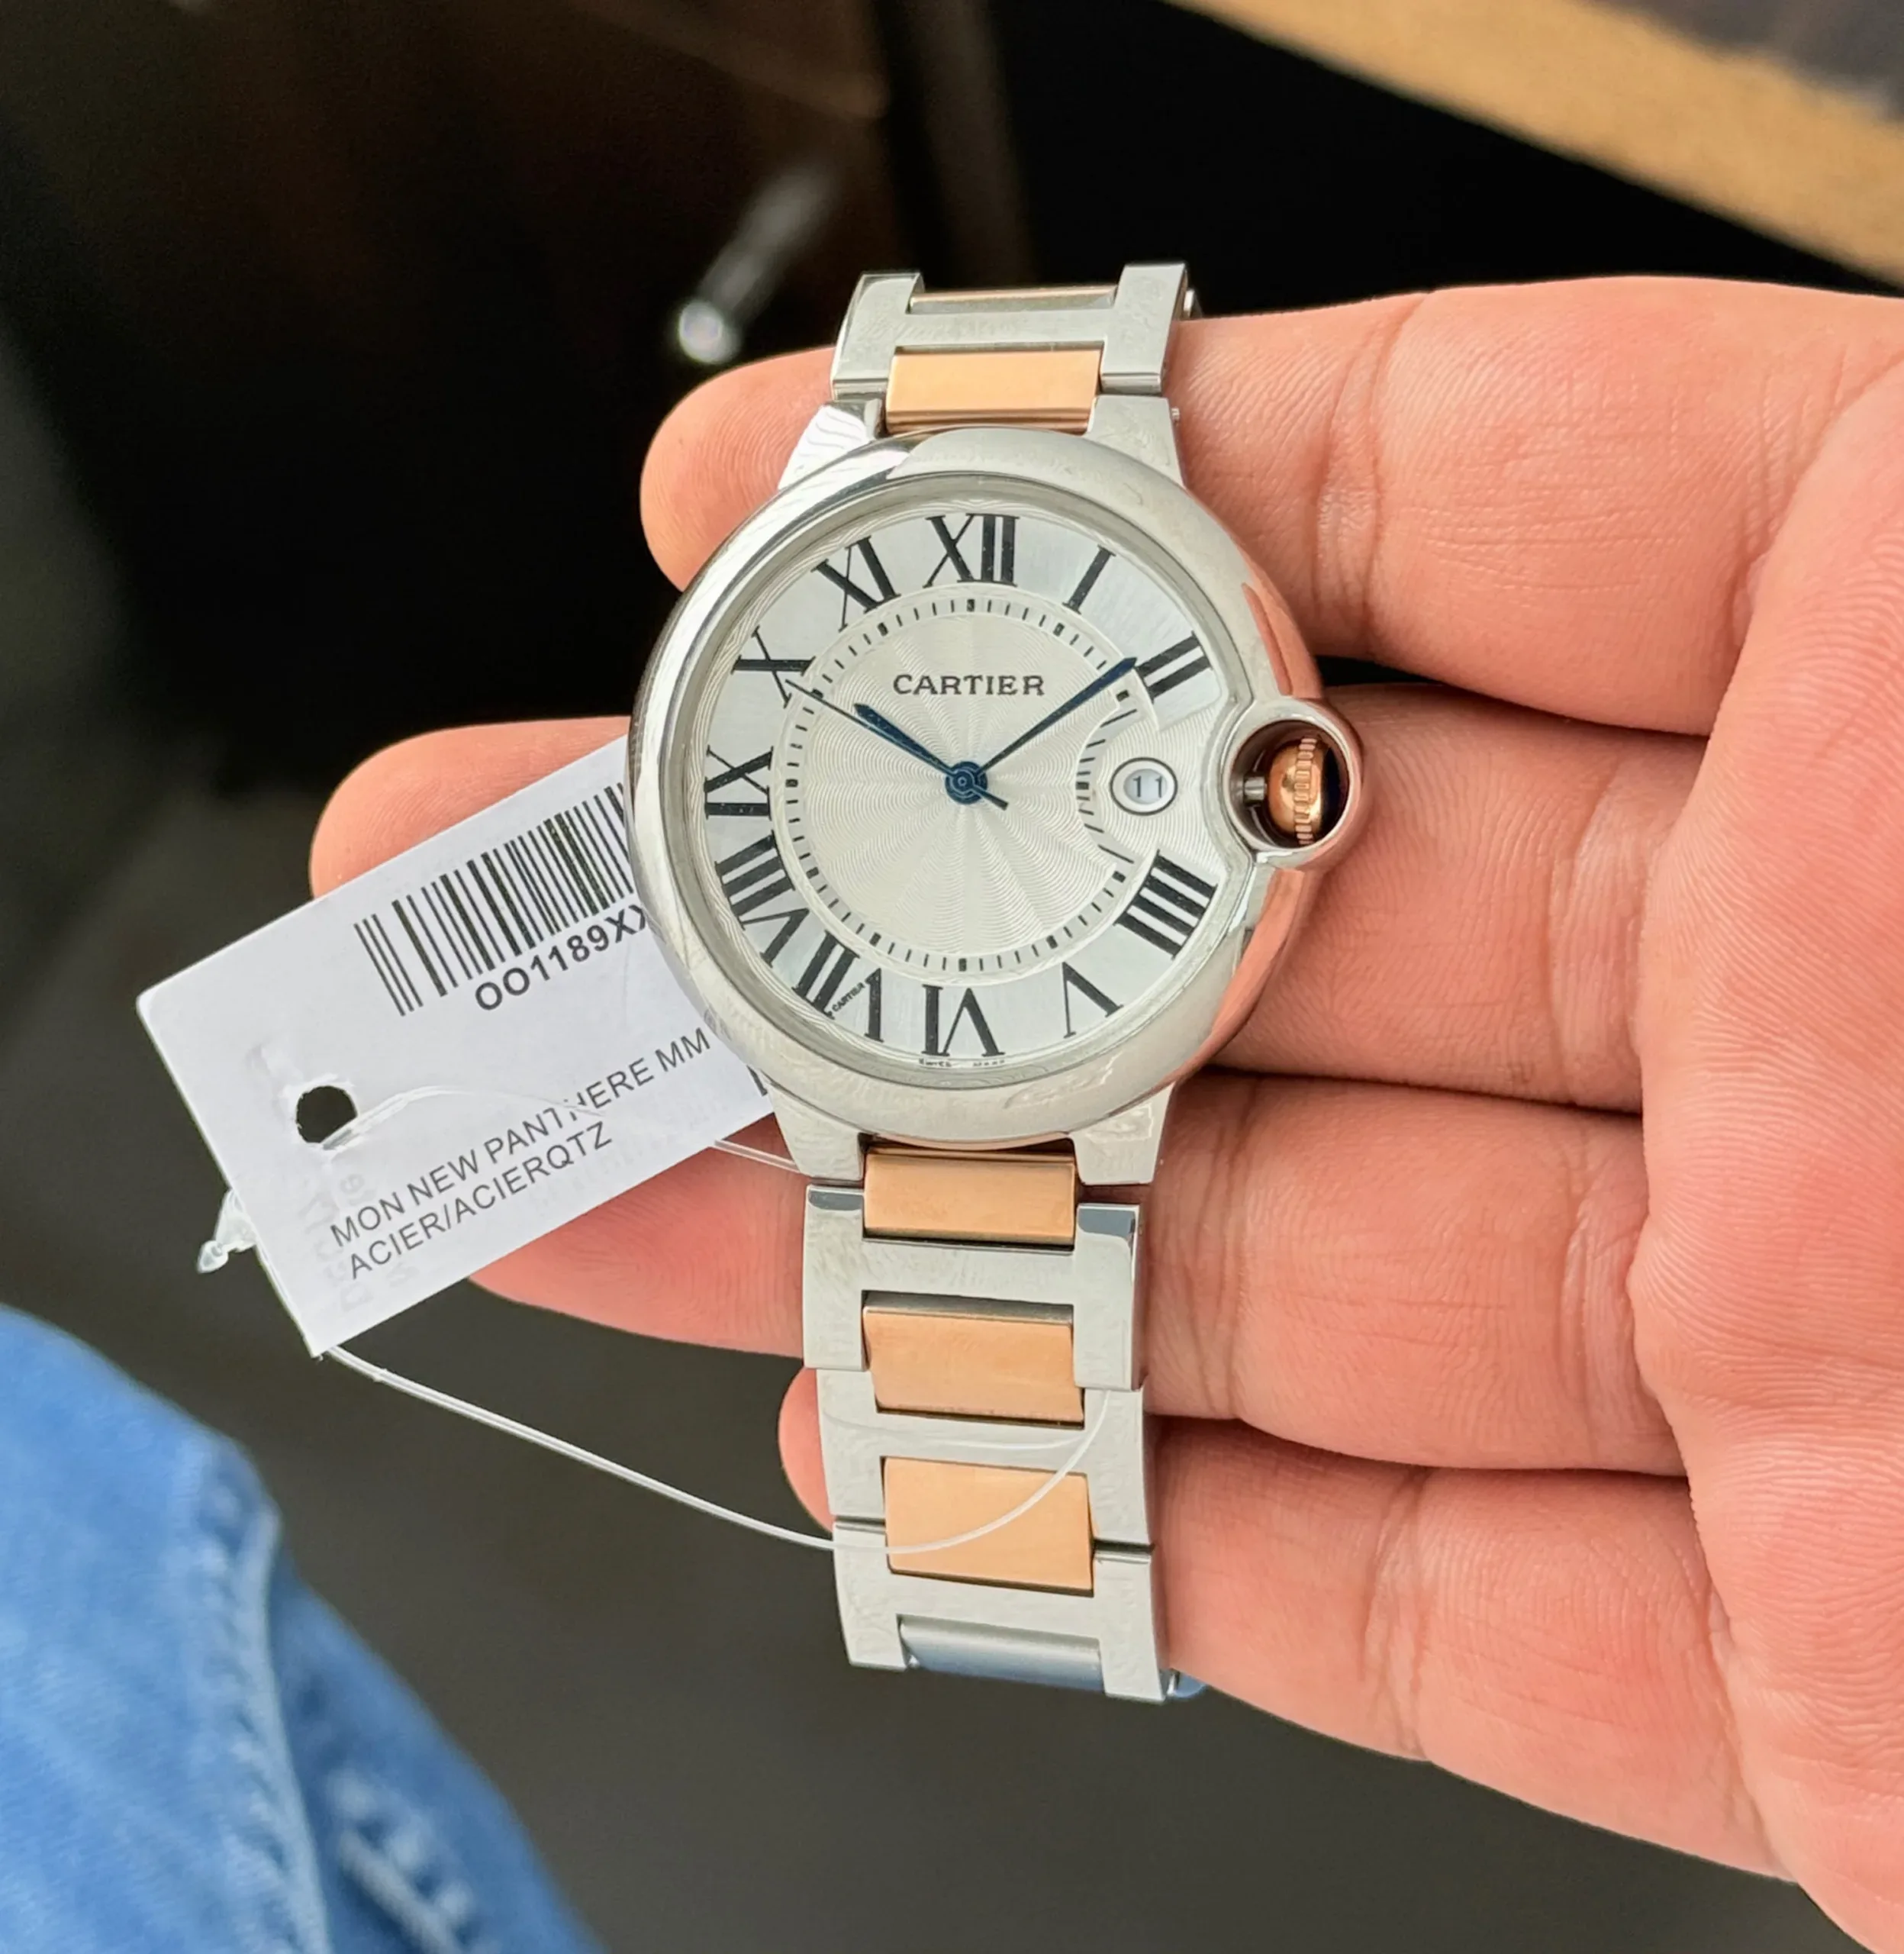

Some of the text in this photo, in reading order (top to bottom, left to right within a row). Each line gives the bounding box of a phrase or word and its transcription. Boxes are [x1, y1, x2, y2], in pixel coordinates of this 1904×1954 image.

[810, 534, 901, 633] XI
[922, 512, 1020, 588] XII
[1062, 543, 1117, 614] I
[730, 624, 817, 709] X
[892, 674, 1045, 696] CARTIER
[1134, 630, 1214, 704] II
[704, 744, 774, 821] IX
[1132, 775, 1164, 799] 11
[714, 830, 810, 969] VIII
[1112, 849, 1219, 961] IIII
[791, 928, 884, 1043] VII
[921, 983, 1006, 1057] VI
[1062, 961, 1124, 1039] V
[330, 1191, 405, 1247] MON
[407, 1149, 481, 1206] NEW
[656, 1027, 711, 1072] MM
[350, 1120, 613, 1280] ACIER/ACIERQTZ
